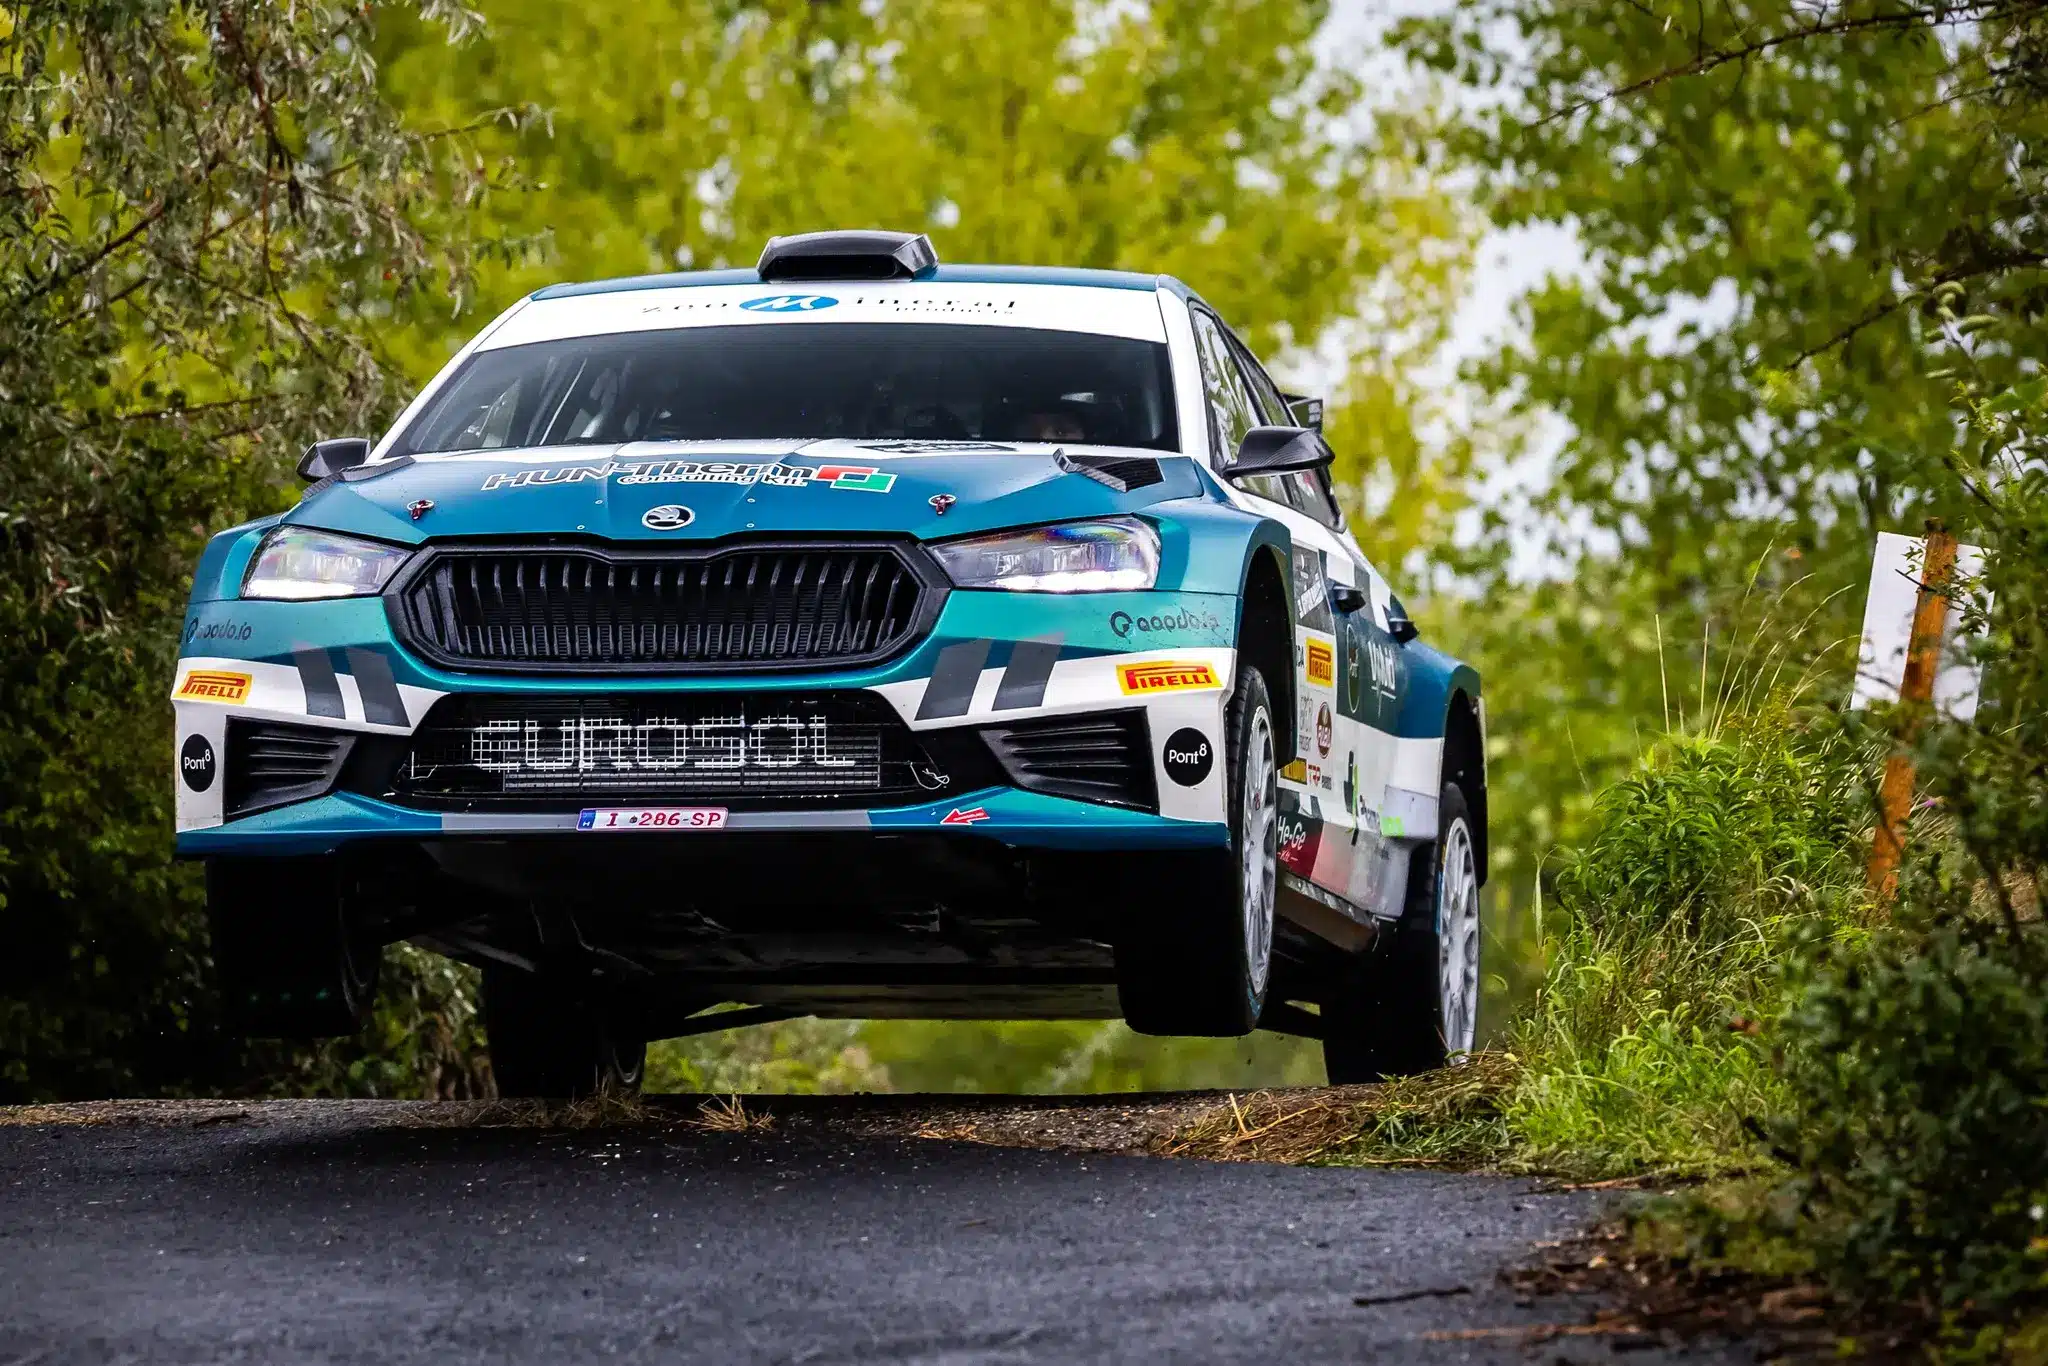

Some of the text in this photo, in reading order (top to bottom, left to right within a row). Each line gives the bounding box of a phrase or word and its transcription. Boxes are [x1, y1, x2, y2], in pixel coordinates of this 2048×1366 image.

[1309, 645, 1332, 681] PIRELLI
[181, 675, 246, 700] PIRELLI
[1125, 665, 1213, 690] PIRELLI
[638, 812, 722, 827] 286-SP
